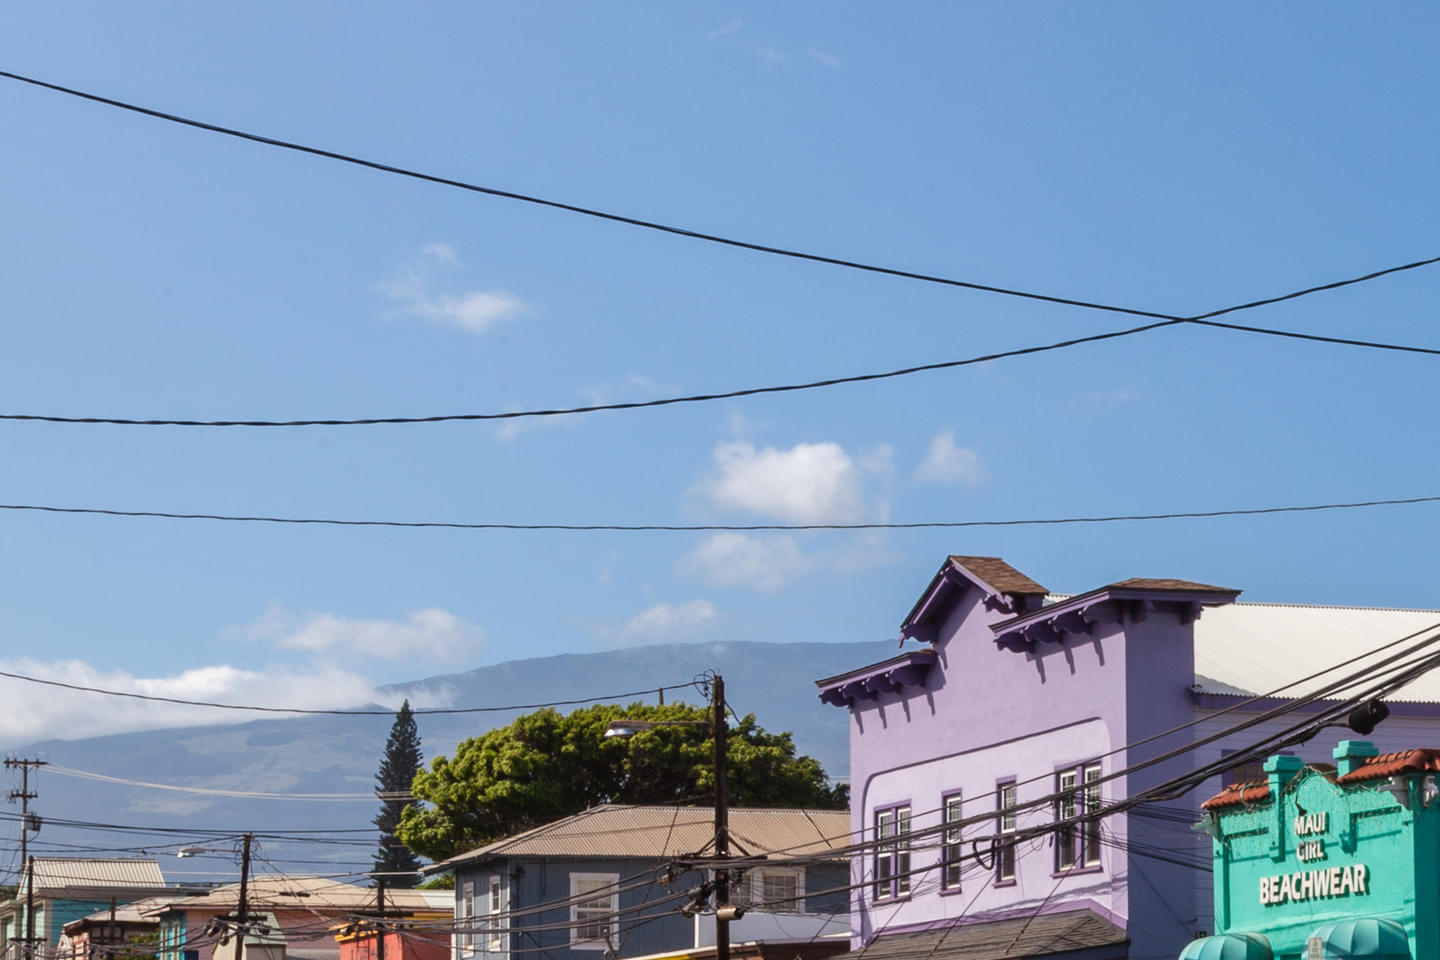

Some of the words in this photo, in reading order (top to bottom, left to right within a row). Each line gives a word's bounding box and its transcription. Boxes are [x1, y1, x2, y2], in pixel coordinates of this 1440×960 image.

[1294, 811, 1328, 836] MAUI
[1295, 841, 1326, 862] GIRL
[1259, 863, 1368, 906] BEACHWEAR
